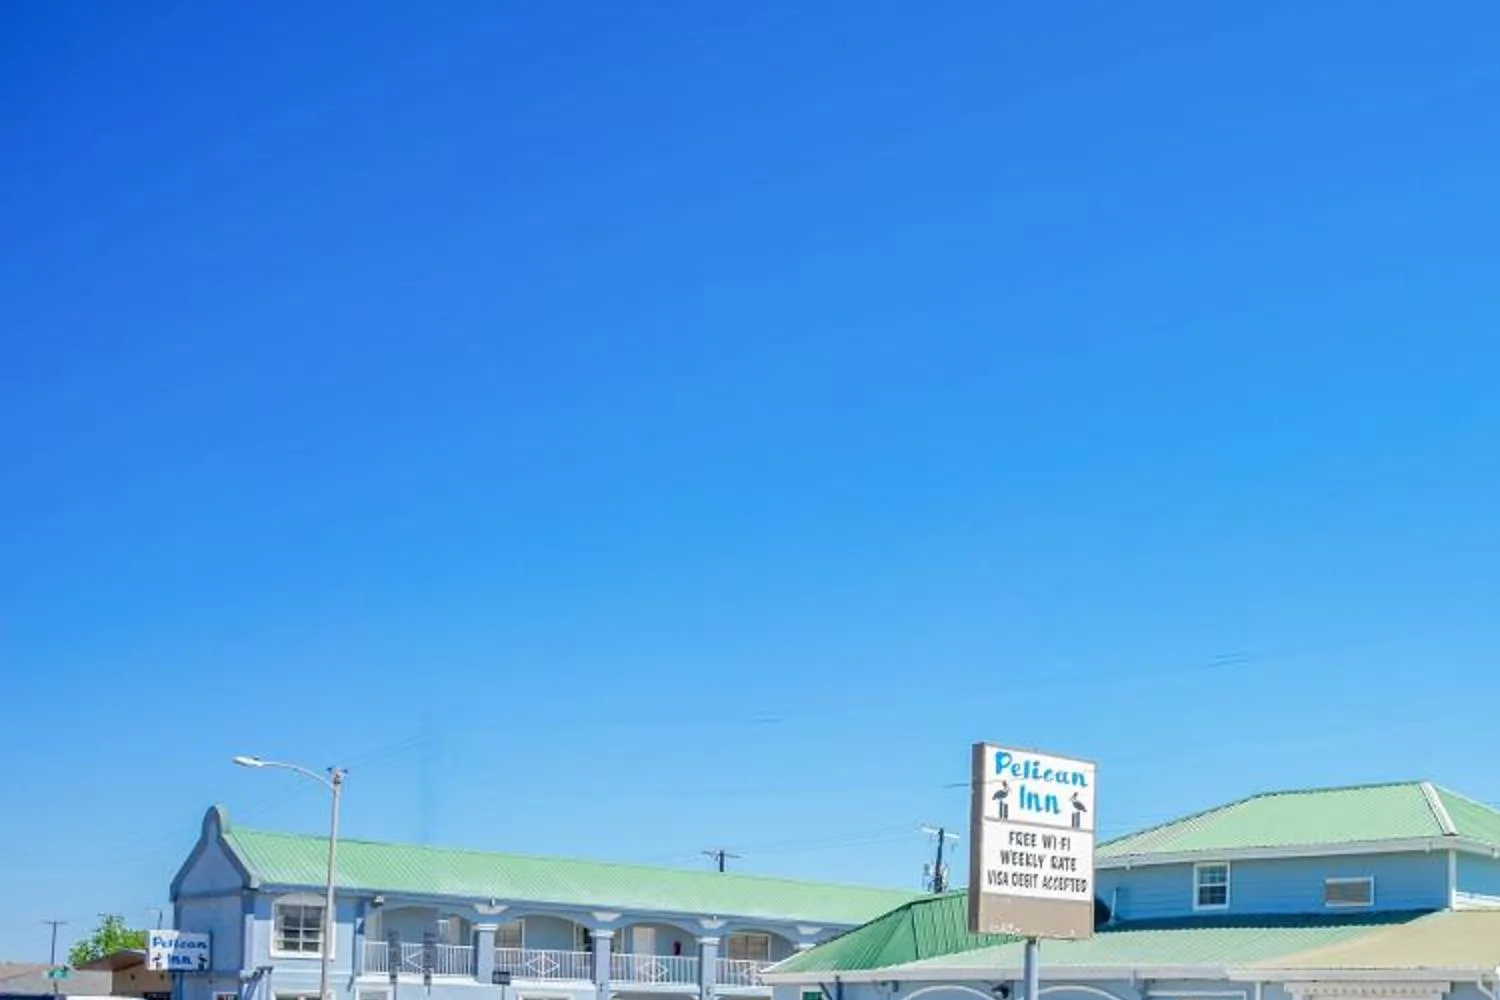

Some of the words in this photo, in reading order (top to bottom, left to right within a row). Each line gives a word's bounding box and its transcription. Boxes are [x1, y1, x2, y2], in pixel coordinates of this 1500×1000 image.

[995, 751, 1089, 788] Pelican
[1019, 785, 1061, 815] Inn
[1009, 831, 1037, 848] FREE
[1000, 849, 1046, 869] WEEKLY
[1051, 855, 1077, 872] RATE
[987, 869, 1009, 886] VISA
[1011, 873, 1039, 889] DEBIT
[1042, 875, 1087, 893] ACCEPTED
[153, 936, 208, 949] Pelican
